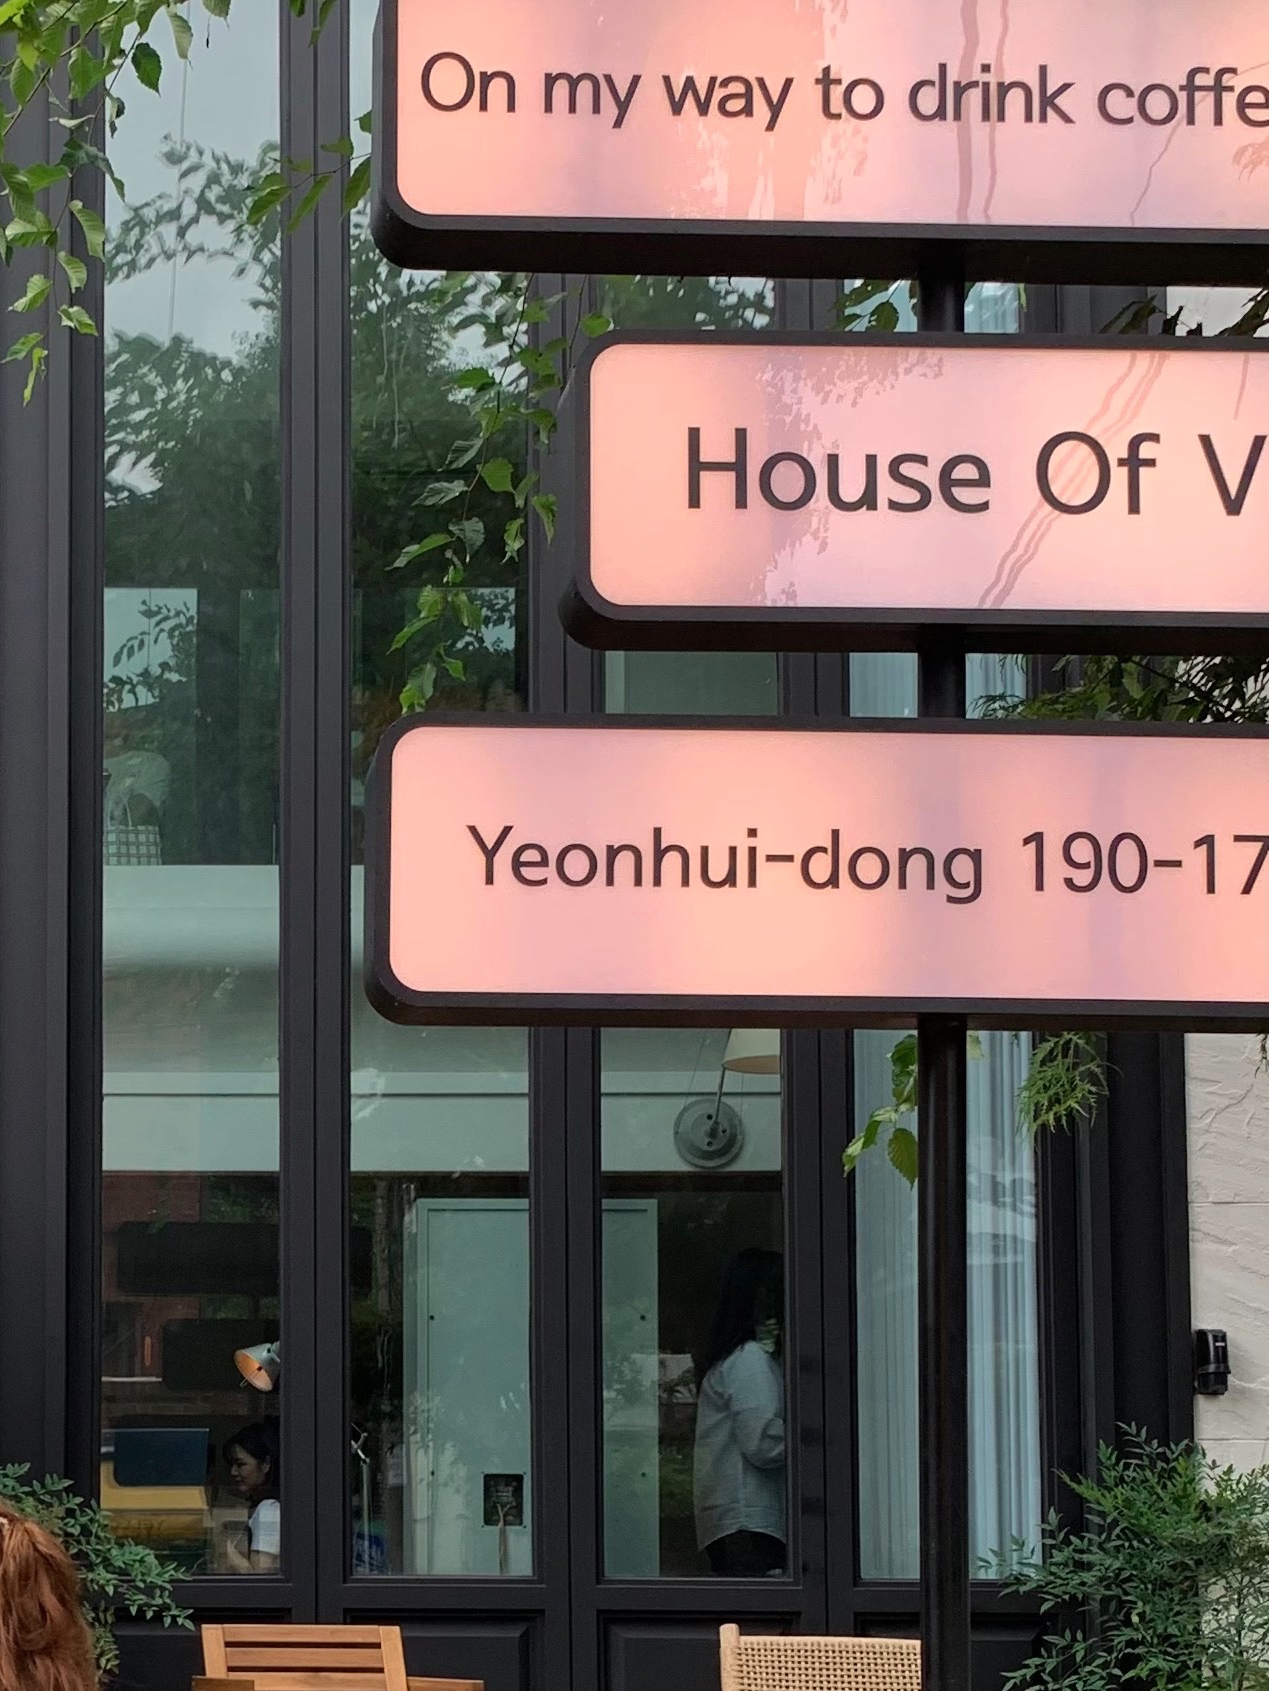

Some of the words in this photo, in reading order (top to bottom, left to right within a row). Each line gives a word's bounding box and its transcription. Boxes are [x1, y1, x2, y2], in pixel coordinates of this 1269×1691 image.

[420, 51, 516, 113] On
[544, 72, 642, 129] my
[661, 75, 794, 132] way
[814, 65, 885, 121] to
[908, 62, 1076, 124] drink
[687, 426, 991, 514] House
[1036, 431, 1161, 515] Of
[1197, 434, 1268, 516] V
[466, 825, 983, 905] Yeonhui-dong
[1022, 831, 1269, 895] 190-17
